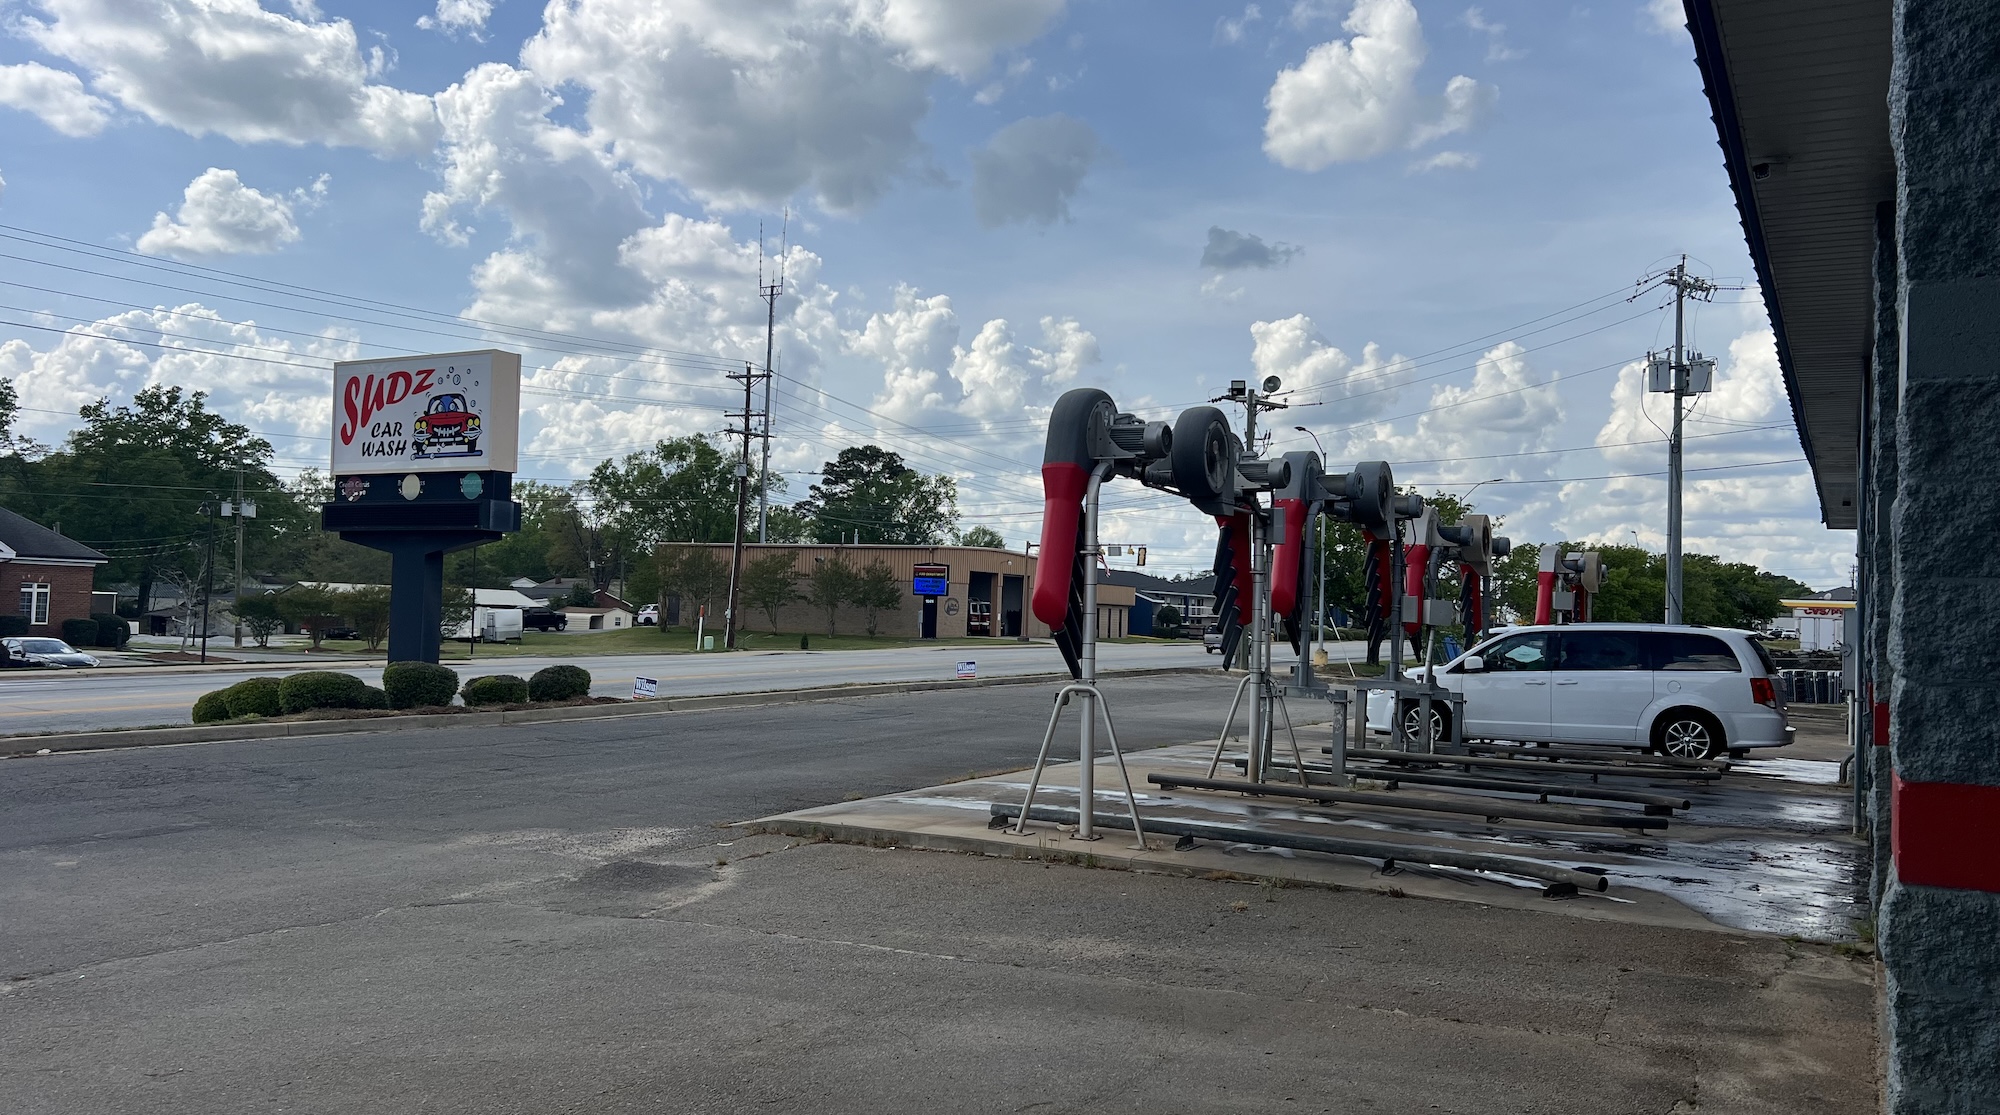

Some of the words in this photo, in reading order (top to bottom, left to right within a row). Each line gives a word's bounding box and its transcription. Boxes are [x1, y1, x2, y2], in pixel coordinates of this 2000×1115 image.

[340, 369, 436, 446] SUDZ
[371, 421, 403, 439] CAR
[361, 439, 407, 457] WASH
[958, 662, 976, 671] Wilson
[636, 678, 656, 692] Wilson
